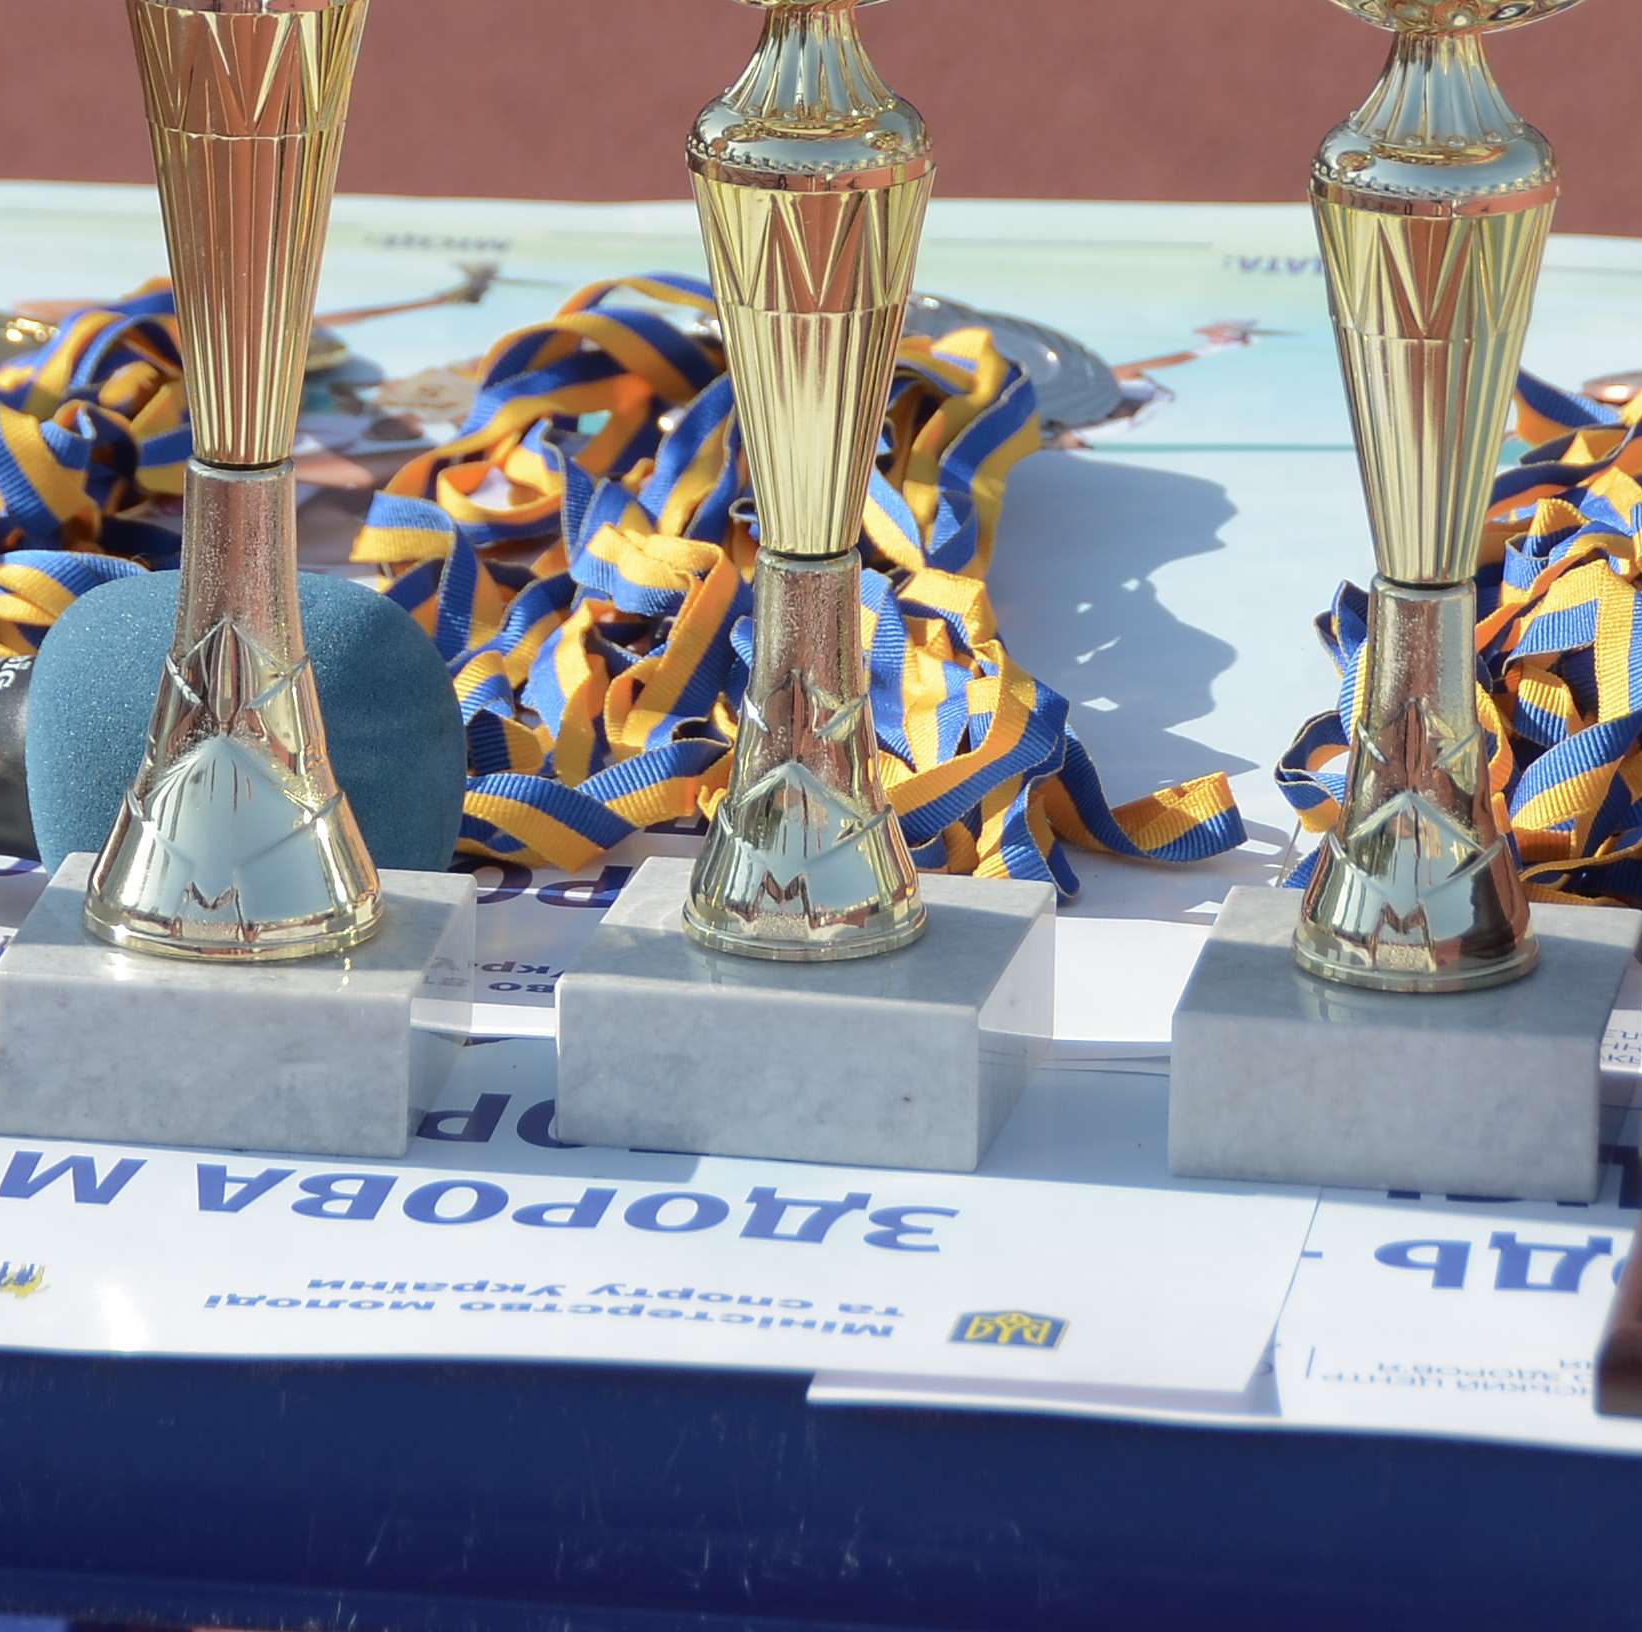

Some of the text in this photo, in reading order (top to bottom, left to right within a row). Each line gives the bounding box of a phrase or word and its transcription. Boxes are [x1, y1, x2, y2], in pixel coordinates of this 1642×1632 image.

[196, 1163, 960, 1253] ЗДОРОВА
[202, 1292, 894, 1339] Міністерство молоді
[305, 1278, 904, 1318] та спорту України
